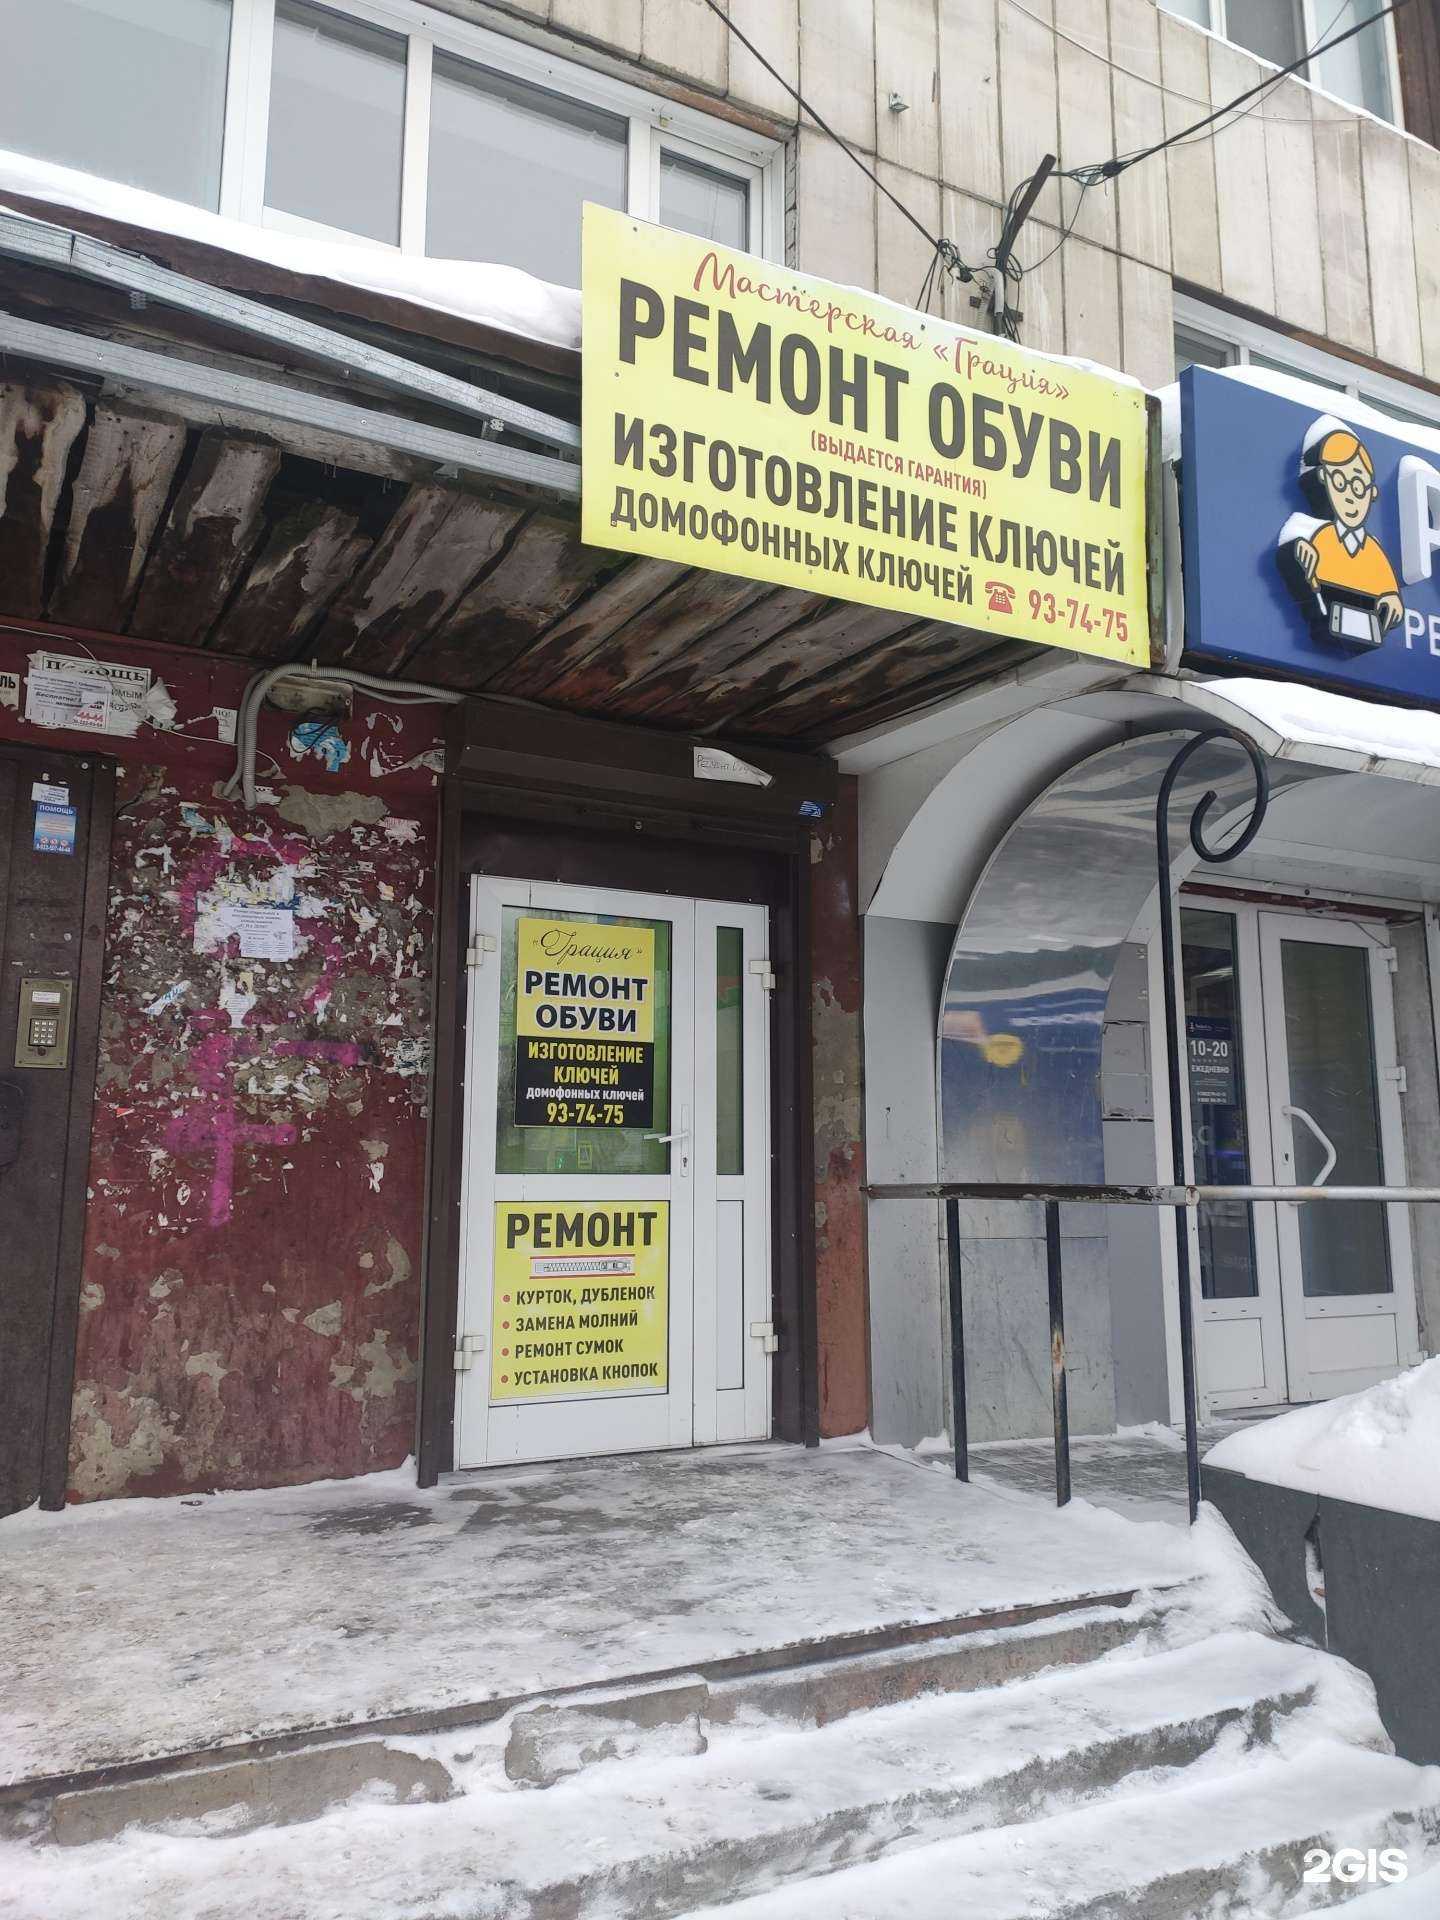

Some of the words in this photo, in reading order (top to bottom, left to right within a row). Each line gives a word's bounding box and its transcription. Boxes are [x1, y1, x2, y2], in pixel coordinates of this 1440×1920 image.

[693, 252, 922, 352] Мастерская
[933, 336, 1070, 401] «Грация»
[618, 278, 910, 443] РЕМОНТ
[928, 382, 1122, 509] ОБУВИ
[810, 429, 904, 475] (ВЫДАЕТСЯ
[907, 459, 988, 500] ГАРАНТИЯ)
[613, 412, 958, 551] ИЗГОТОВЛЕНИЕ
[969, 511, 1126, 596] КЛЮЧЕЙ
[611, 486, 850, 575] ДОМОФОННЫХ
[858, 546, 973, 606] КЛЮЧЕЙ
[1028, 589, 1128, 642] 93-74-75
[525, 970, 648, 1001] РЕМОНТ
[535, 1004, 637, 1033] ОБУВИ
[528, 1041, 644, 1064] ИЗГОТОВЛЕНИЕ
[1190, 1039, 1228, 1057] 10-20
[553, 1065, 619, 1085] КЛЮЧЕЙ
[1191, 1064, 1230, 1074] ЕЖЕДНЕВНО
[526, 1086, 600, 1100] домофонных
[602, 1089, 644, 1102] ключей
[547, 1103, 625, 1125] 93-74-75
[506, 1212, 658, 1249] РЕМОНТ
[516, 1289, 577, 1306] КУРТОК,
[580, 1286, 656, 1304] ДУБЛЕНОК
[515, 1315, 575, 1332] ЗАМЕНА
[579, 1310, 639, 1329] МОЛНИЙ
[515, 1341, 573, 1359] РЕМОНТ
[576, 1339, 624, 1355] СУМОК
[514, 1368, 598, 1386] УСТАНОВКА
[602, 1362, 659, 1380] КНОПОК
